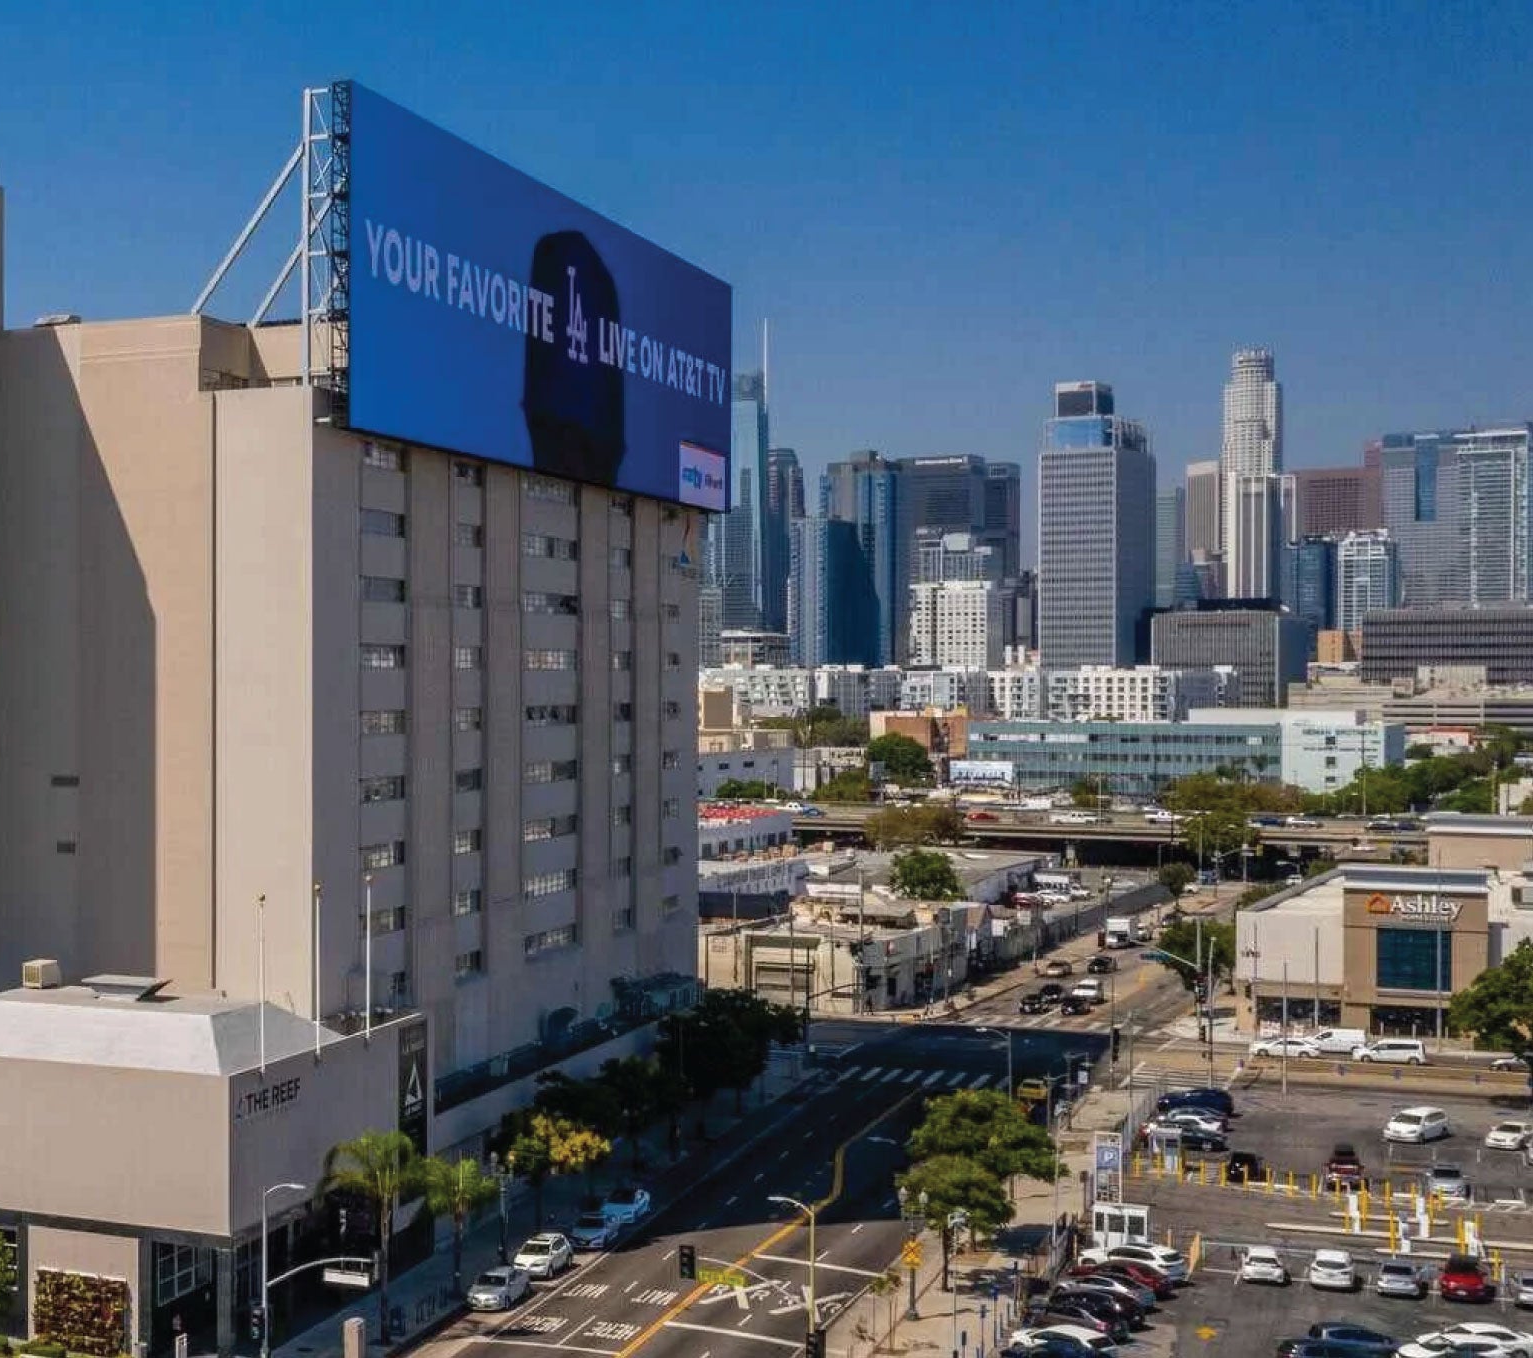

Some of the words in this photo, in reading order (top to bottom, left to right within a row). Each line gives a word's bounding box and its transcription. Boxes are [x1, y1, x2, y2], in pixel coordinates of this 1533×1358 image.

[365, 219, 440, 300] YOUR
[447, 253, 554, 343] FAVORITE
[599, 317, 636, 374] LIVE
[640, 335, 663, 383] ON
[667, 348, 704, 398] AT&T
[706, 361, 726, 404] TV
[1390, 893, 1463, 921] Ashley
[245, 1088, 269, 1114] THE
[272, 1076, 301, 1106] REEF
